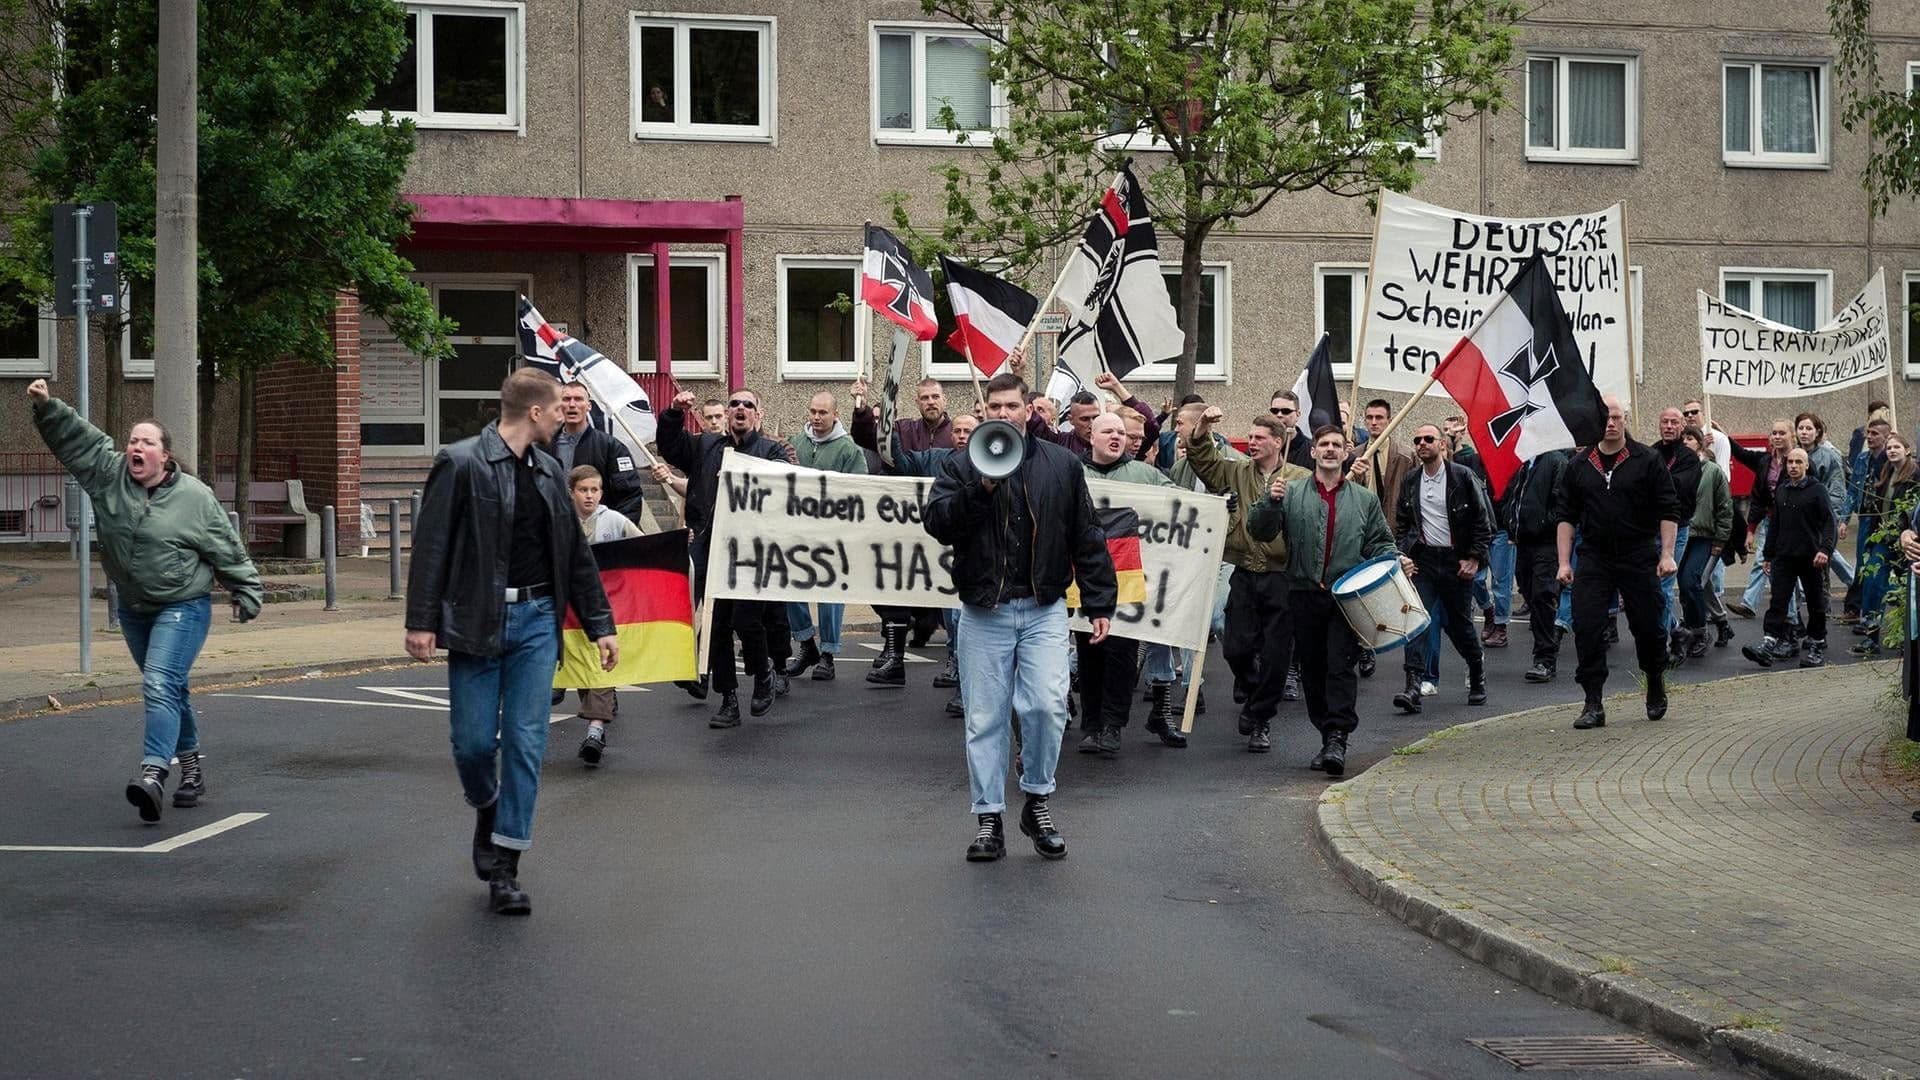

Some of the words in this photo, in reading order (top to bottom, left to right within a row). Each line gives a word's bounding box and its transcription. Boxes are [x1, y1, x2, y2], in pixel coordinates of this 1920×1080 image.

[1453, 216, 1607, 257] DEUTSCHE
[1554, 253, 1618, 293] EUCH!
[1706, 359, 1776, 386] FREMD
[1781, 362, 1796, 384] IM
[724, 471, 772, 514] Wir
[786, 472, 865, 523] haben
[727, 536, 849, 592] HASS!
[871, 541, 960, 595] HAS
